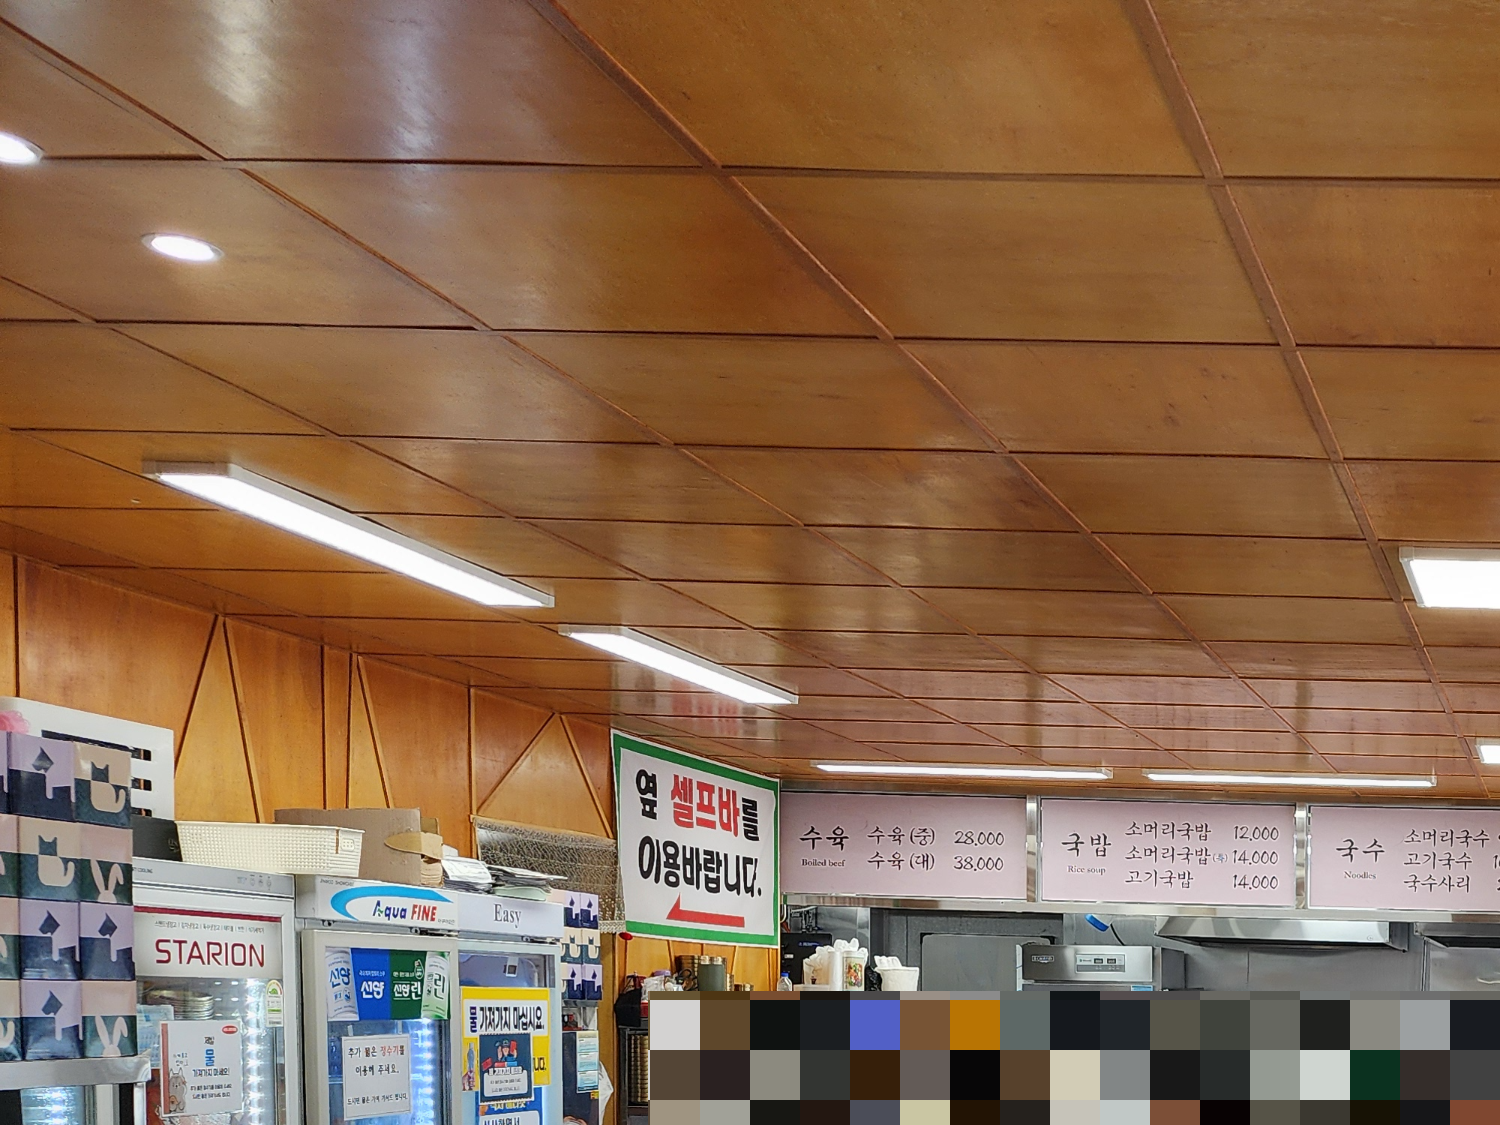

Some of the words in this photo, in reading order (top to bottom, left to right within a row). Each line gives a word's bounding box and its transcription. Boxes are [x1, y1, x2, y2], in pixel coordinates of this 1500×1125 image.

[635, 769, 658, 821] 옆
[670, 773, 760, 842] 셀프바를
[800, 826, 849, 851] 수육
[1124, 821, 1212, 842] 소머리국밥
[1404, 829, 1490, 848] 소머리국수
[1061, 833, 1112, 858] 국밥
[1336, 839, 1385, 863] 국수
[638, 835, 762, 898] 이용바랍니다.
[801, 858, 826, 867] Boiled
[828, 858, 845, 867] beef
[1067, 865, 1085, 873] Rice
[1087, 866, 1106, 876] soup
[1404, 852, 1473, 871] 고기국수
[1125, 870, 1194, 890] 고기국밥
[1344, 871, 1377, 880] Noodles
[1404, 874, 1470, 893] 국수사리
[372, 899, 407, 921] Aqua
[411, 903, 437, 922] FINE
[494, 903, 522, 928] Easy
[155, 938, 265, 968] STARION
[469, 1006, 478, 1033] 물
[479, 1006, 511, 1032] 가져가지
[513, 1006, 545, 1031] 마십시요.
[205, 1048, 215, 1067] 물
[348, 1047, 361, 1058] 추가
[364, 1046, 377, 1058] 물은
[380, 1045, 405, 1056] 정수기를
